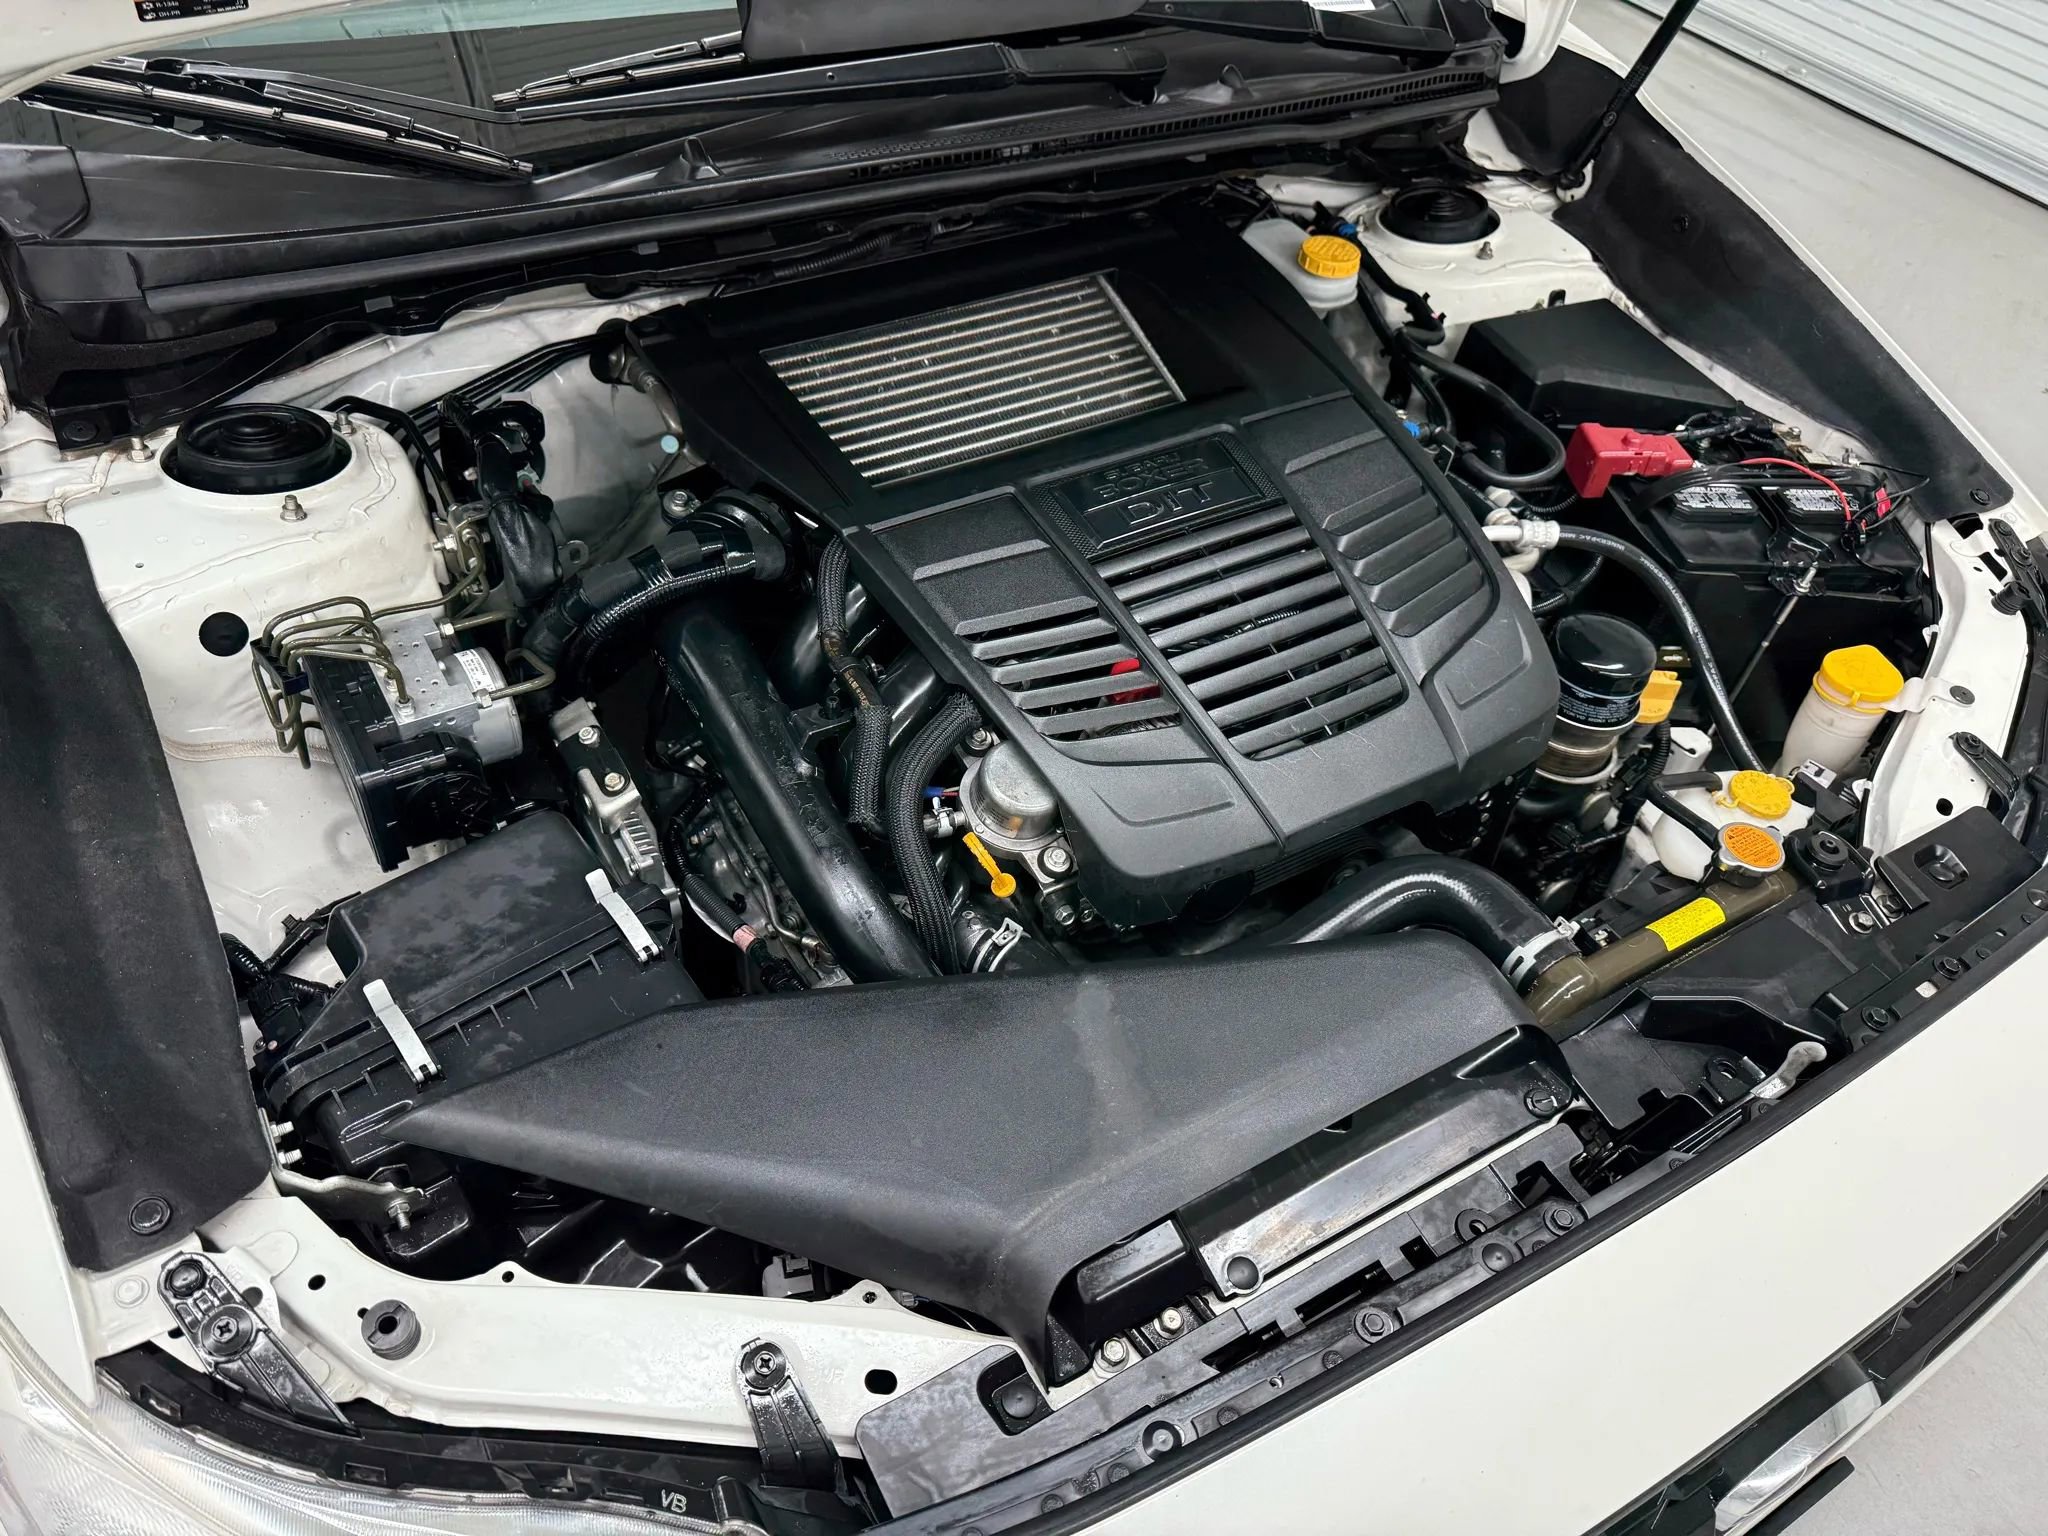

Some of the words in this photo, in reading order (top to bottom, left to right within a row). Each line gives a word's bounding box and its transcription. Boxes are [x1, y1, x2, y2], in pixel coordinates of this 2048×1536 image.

[1093, 458, 1209, 498] BOXER
[1126, 480, 1214, 525] DIT
[660, 1488, 687, 1514] VB
